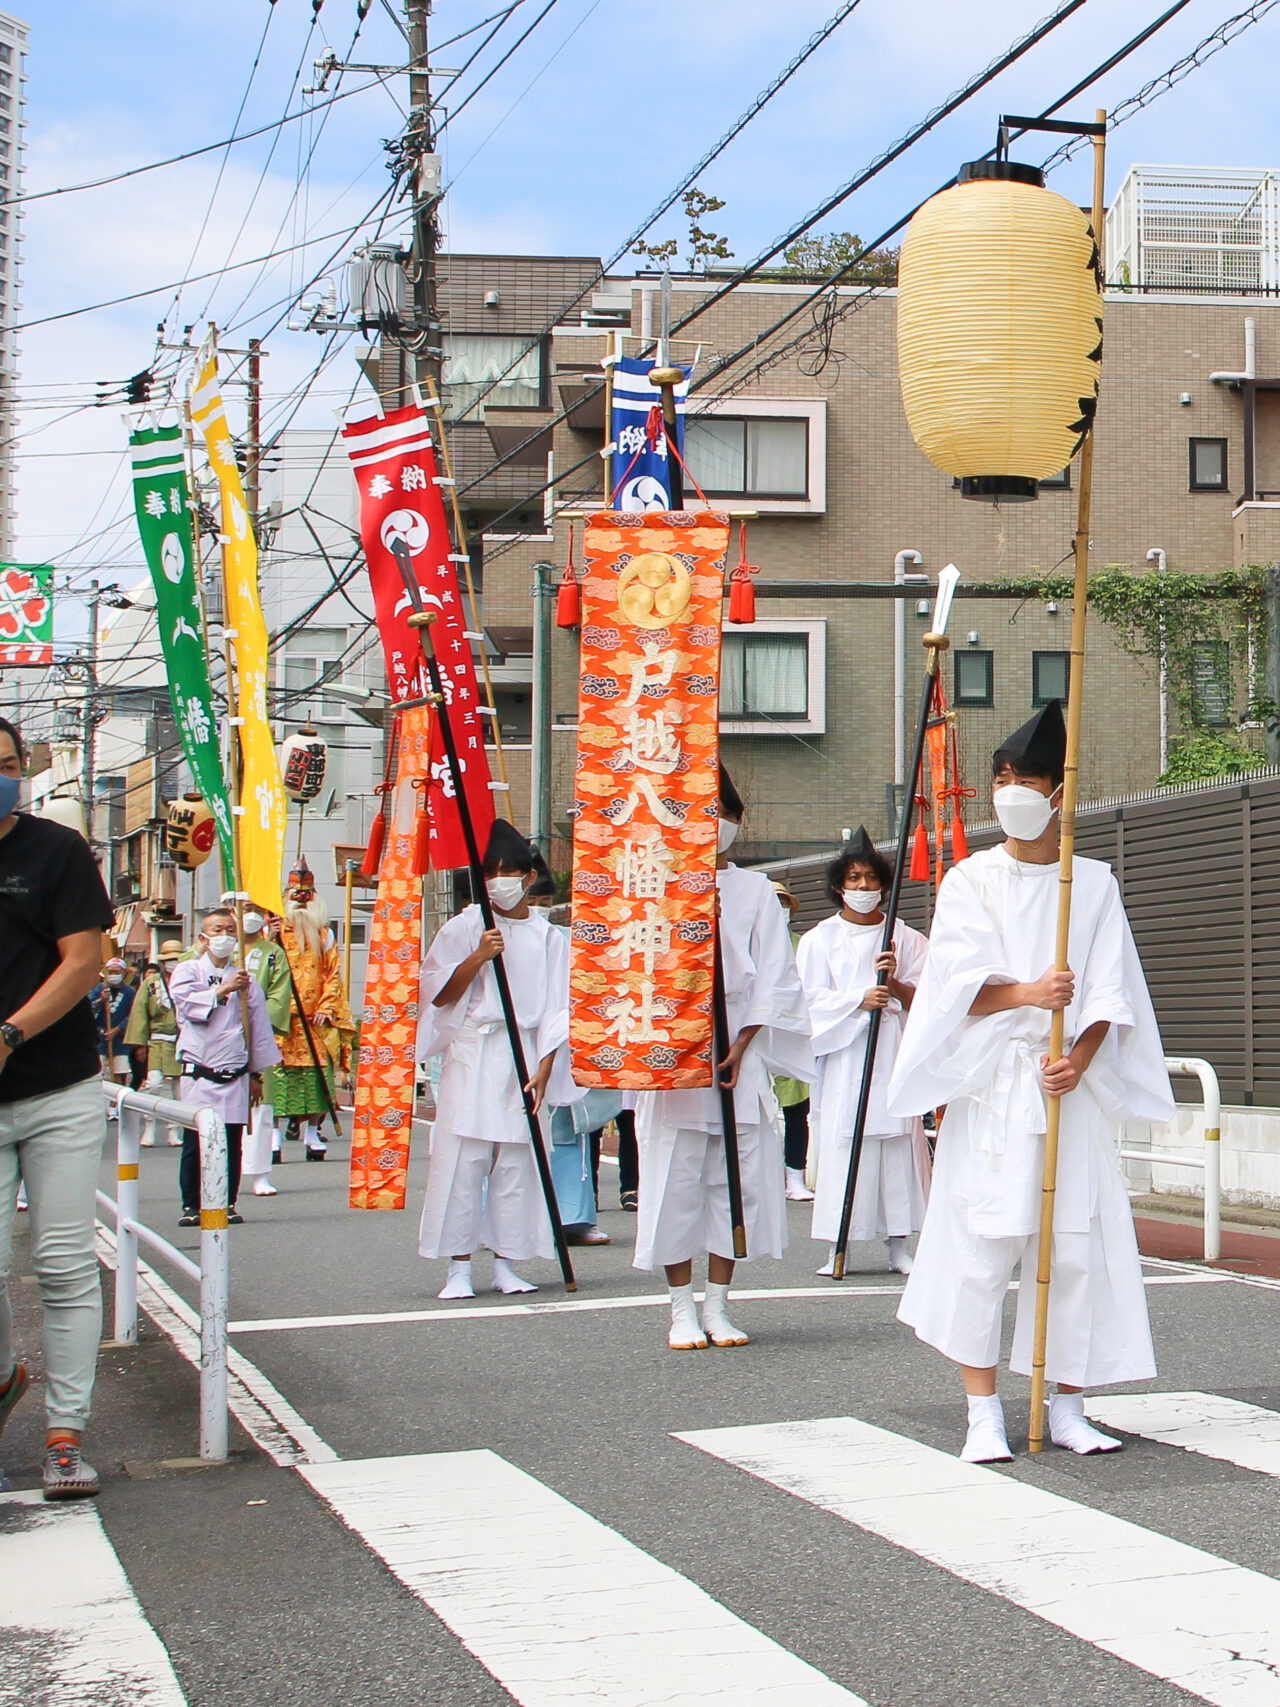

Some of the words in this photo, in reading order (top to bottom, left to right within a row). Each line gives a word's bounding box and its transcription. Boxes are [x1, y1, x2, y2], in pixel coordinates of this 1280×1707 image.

[144, 487, 182, 519] 奉納
[368, 464, 428, 500] 奉納
[436, 564, 478, 749] 平成二十四年三月
[604, 642, 684, 1045] 戸越八幡神社
